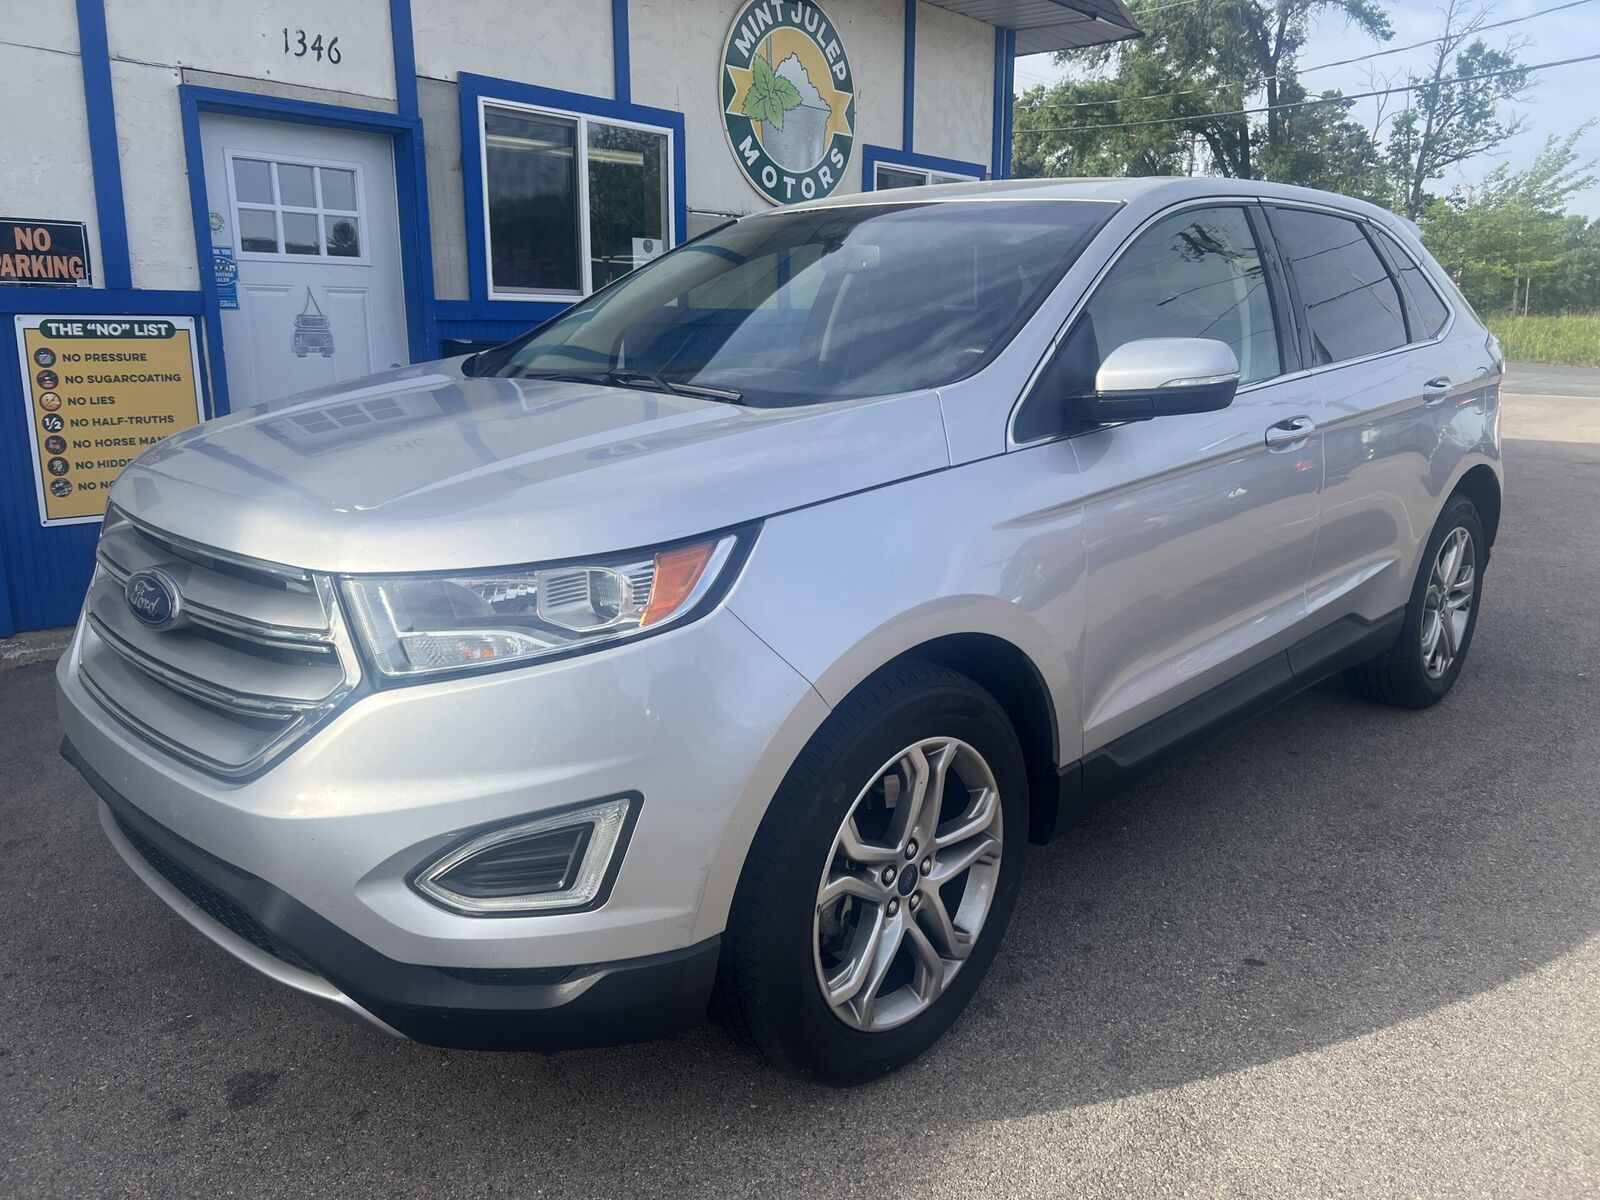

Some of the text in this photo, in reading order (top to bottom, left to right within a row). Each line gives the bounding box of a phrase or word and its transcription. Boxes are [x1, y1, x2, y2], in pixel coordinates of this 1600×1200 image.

[282, 27, 342, 65] 1346
[735, 0, 847, 81] MINT JULEP
[738, 135, 844, 199] MOTORS
[14, 226, 51, 251] NO
[0, 253, 85, 280] ARKING
[47, 323, 83, 336] THE
[134, 324, 168, 336] LIST
[62, 353, 148, 362] NO PRESSURE
[65, 373, 182, 384] NO SUGARCOATING
[67, 396, 116, 406] NO LIES
[70, 415, 175, 427] NO HALF-TRUTHS
[73, 439, 92, 449] NO
[95, 437, 136, 448] HORSE
[75, 461, 94, 470] NO
[78, 482, 97, 491] NO
[131, 580, 160, 616] Ford
